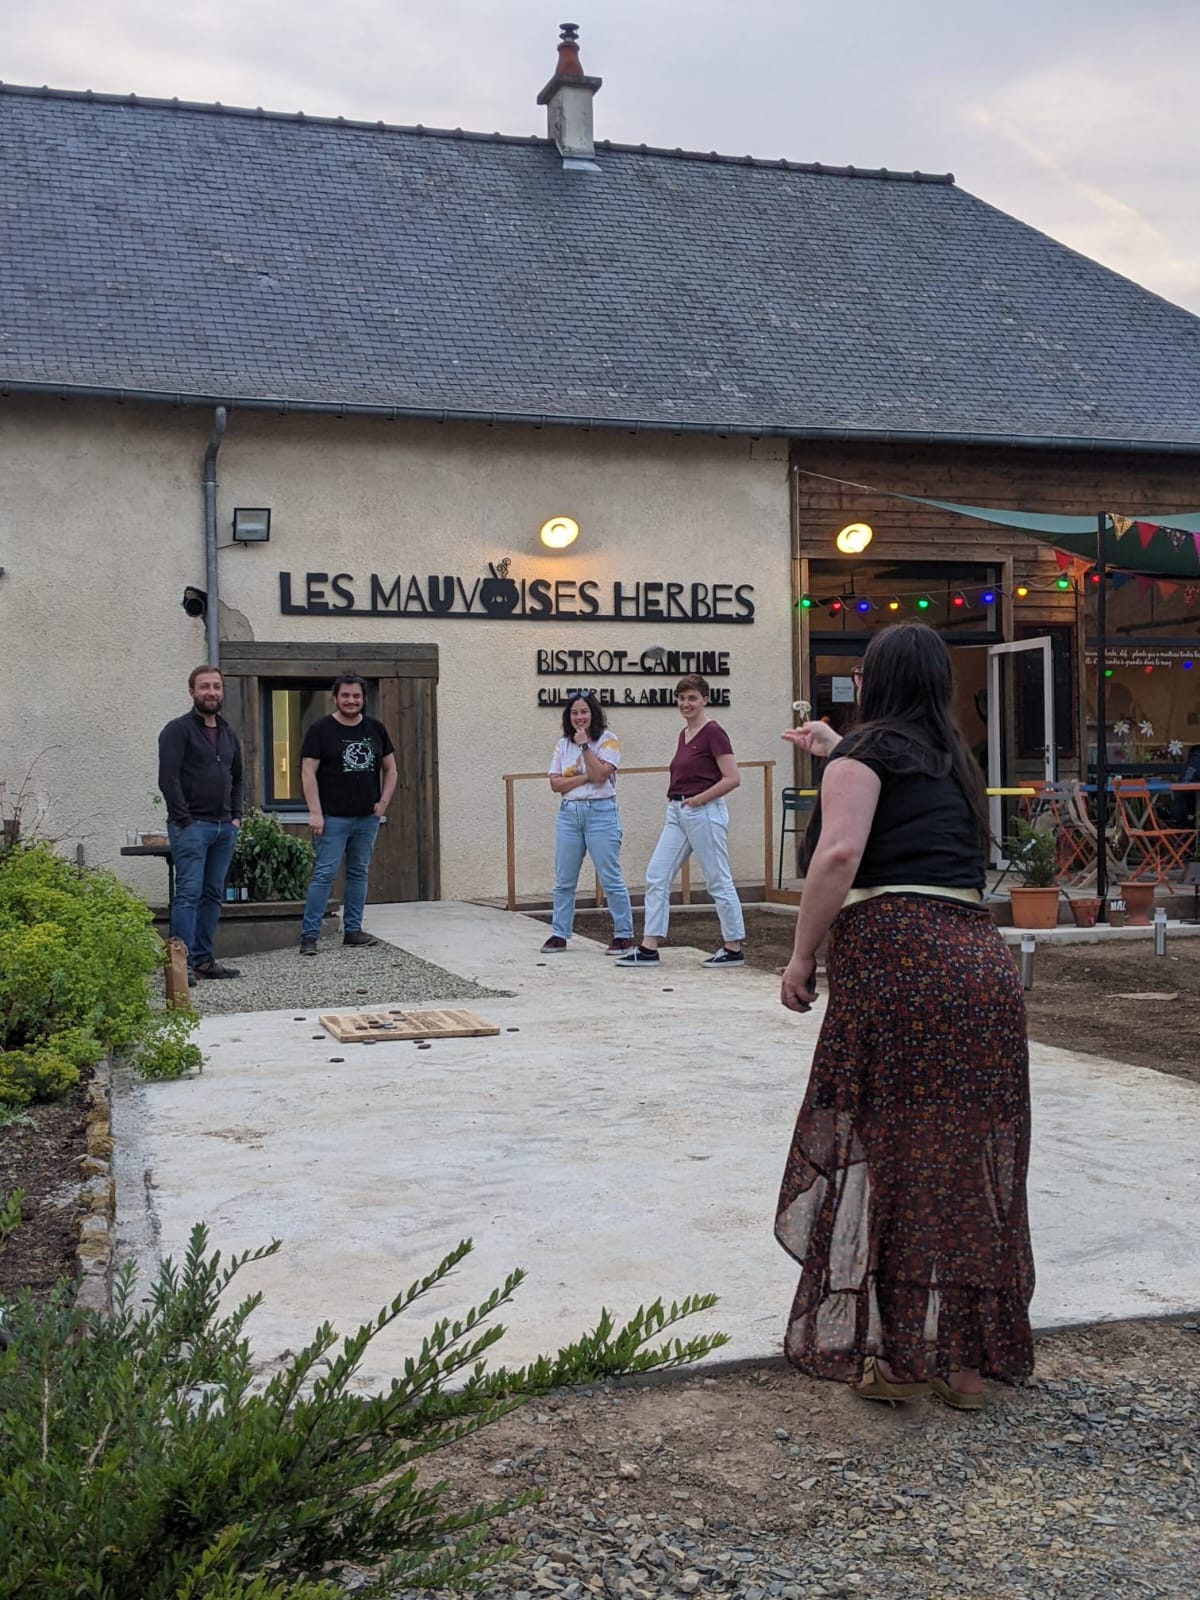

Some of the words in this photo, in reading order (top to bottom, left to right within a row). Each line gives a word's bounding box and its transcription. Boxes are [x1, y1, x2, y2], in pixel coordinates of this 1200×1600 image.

[280, 571, 355, 614] LES
[614, 581, 755, 621] HERBES
[537, 648, 731, 675] BISTROT-CANTINE
[538, 687, 621, 706] CULTREL
[624, 687, 637, 704] &
[640, 687, 731, 706] ARTIUE
